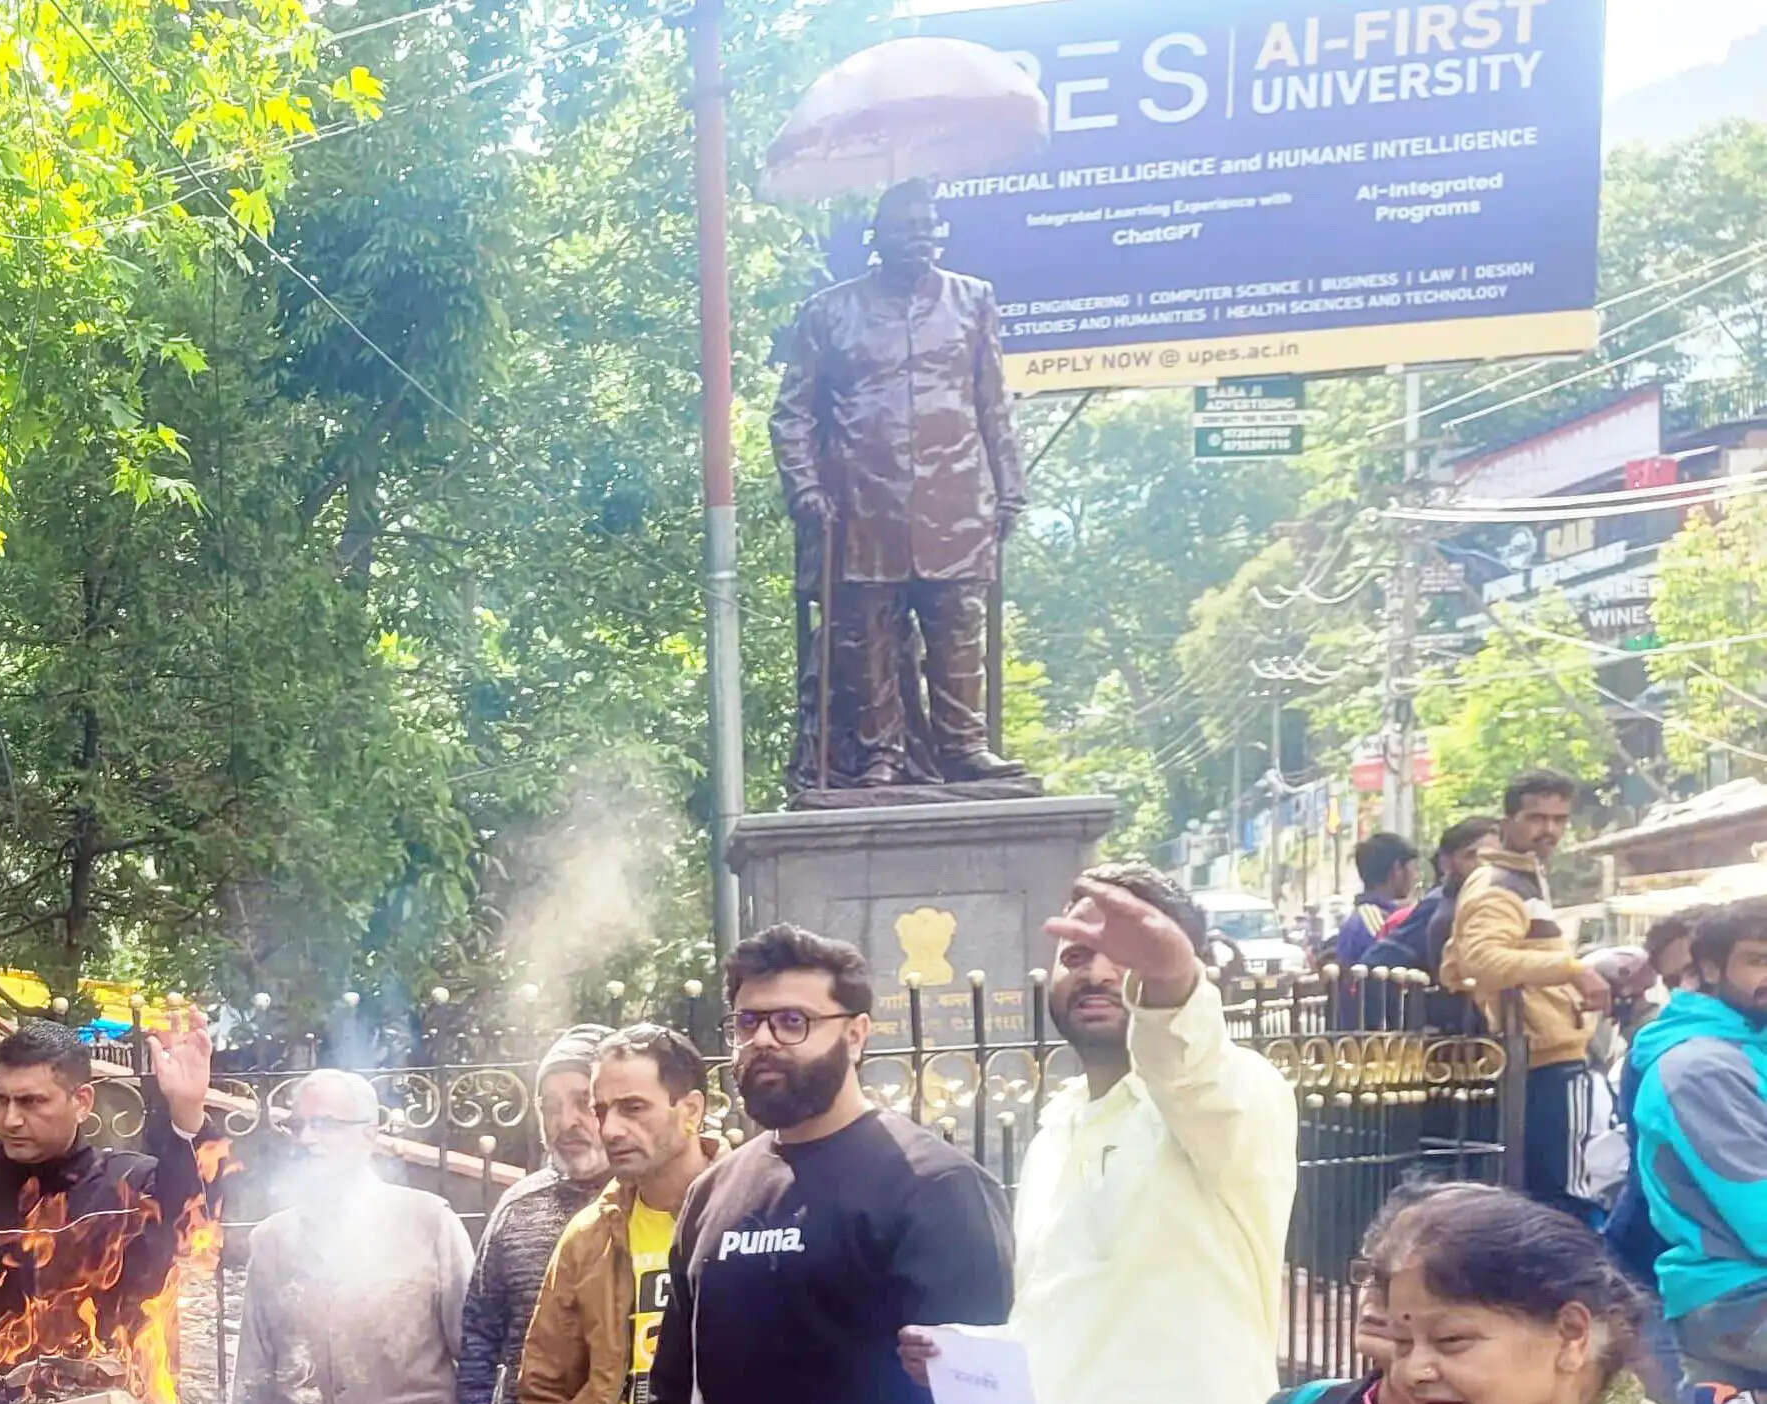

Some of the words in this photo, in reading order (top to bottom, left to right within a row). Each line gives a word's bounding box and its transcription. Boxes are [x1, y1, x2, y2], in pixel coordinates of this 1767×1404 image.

[1254, 0, 1547, 71] AI-FIRST
[1251, 50, 1544, 115] UNIVERSITY
[934, 173, 1054, 200] ARTIFICIAL
[1058, 156, 1217, 189] INTELLIGENCE
[1220, 153, 1262, 174] and
[1267, 142, 1367, 170] HUMANE
[1372, 126, 1538, 161] INTELLIGENCE
[1355, 172, 1504, 202] AI-Integrated
[1375, 199, 1481, 224] Programs
[1112, 222, 1204, 247] ChatGPT
[1321, 272, 1399, 292] BUSINESS
[1418, 268, 1455, 285] LAW
[1474, 261, 1535, 280] DESIGN
[1029, 293, 1130, 316] ENGINEERING
[1149, 284, 1233, 306] COMPUTER
[1235, 279, 1301, 299] SCIENCE
[1226, 298, 1287, 319] HEALTH
[1290, 291, 1365, 315] SCIENCES
[1368, 291, 1402, 309] AND
[1404, 284, 1509, 306] TECHNOLOGY
[1013, 318, 1078, 337] STUDIES
[1079, 316, 1112, 332] AND
[1114, 307, 1207, 329] HUMANITIES
[1025, 354, 1095, 378] APPLY
[1101, 351, 1153, 371] NOW
[1187, 341, 1299, 367] upes.ac.in
[1587, 605, 1648, 628] WINE
